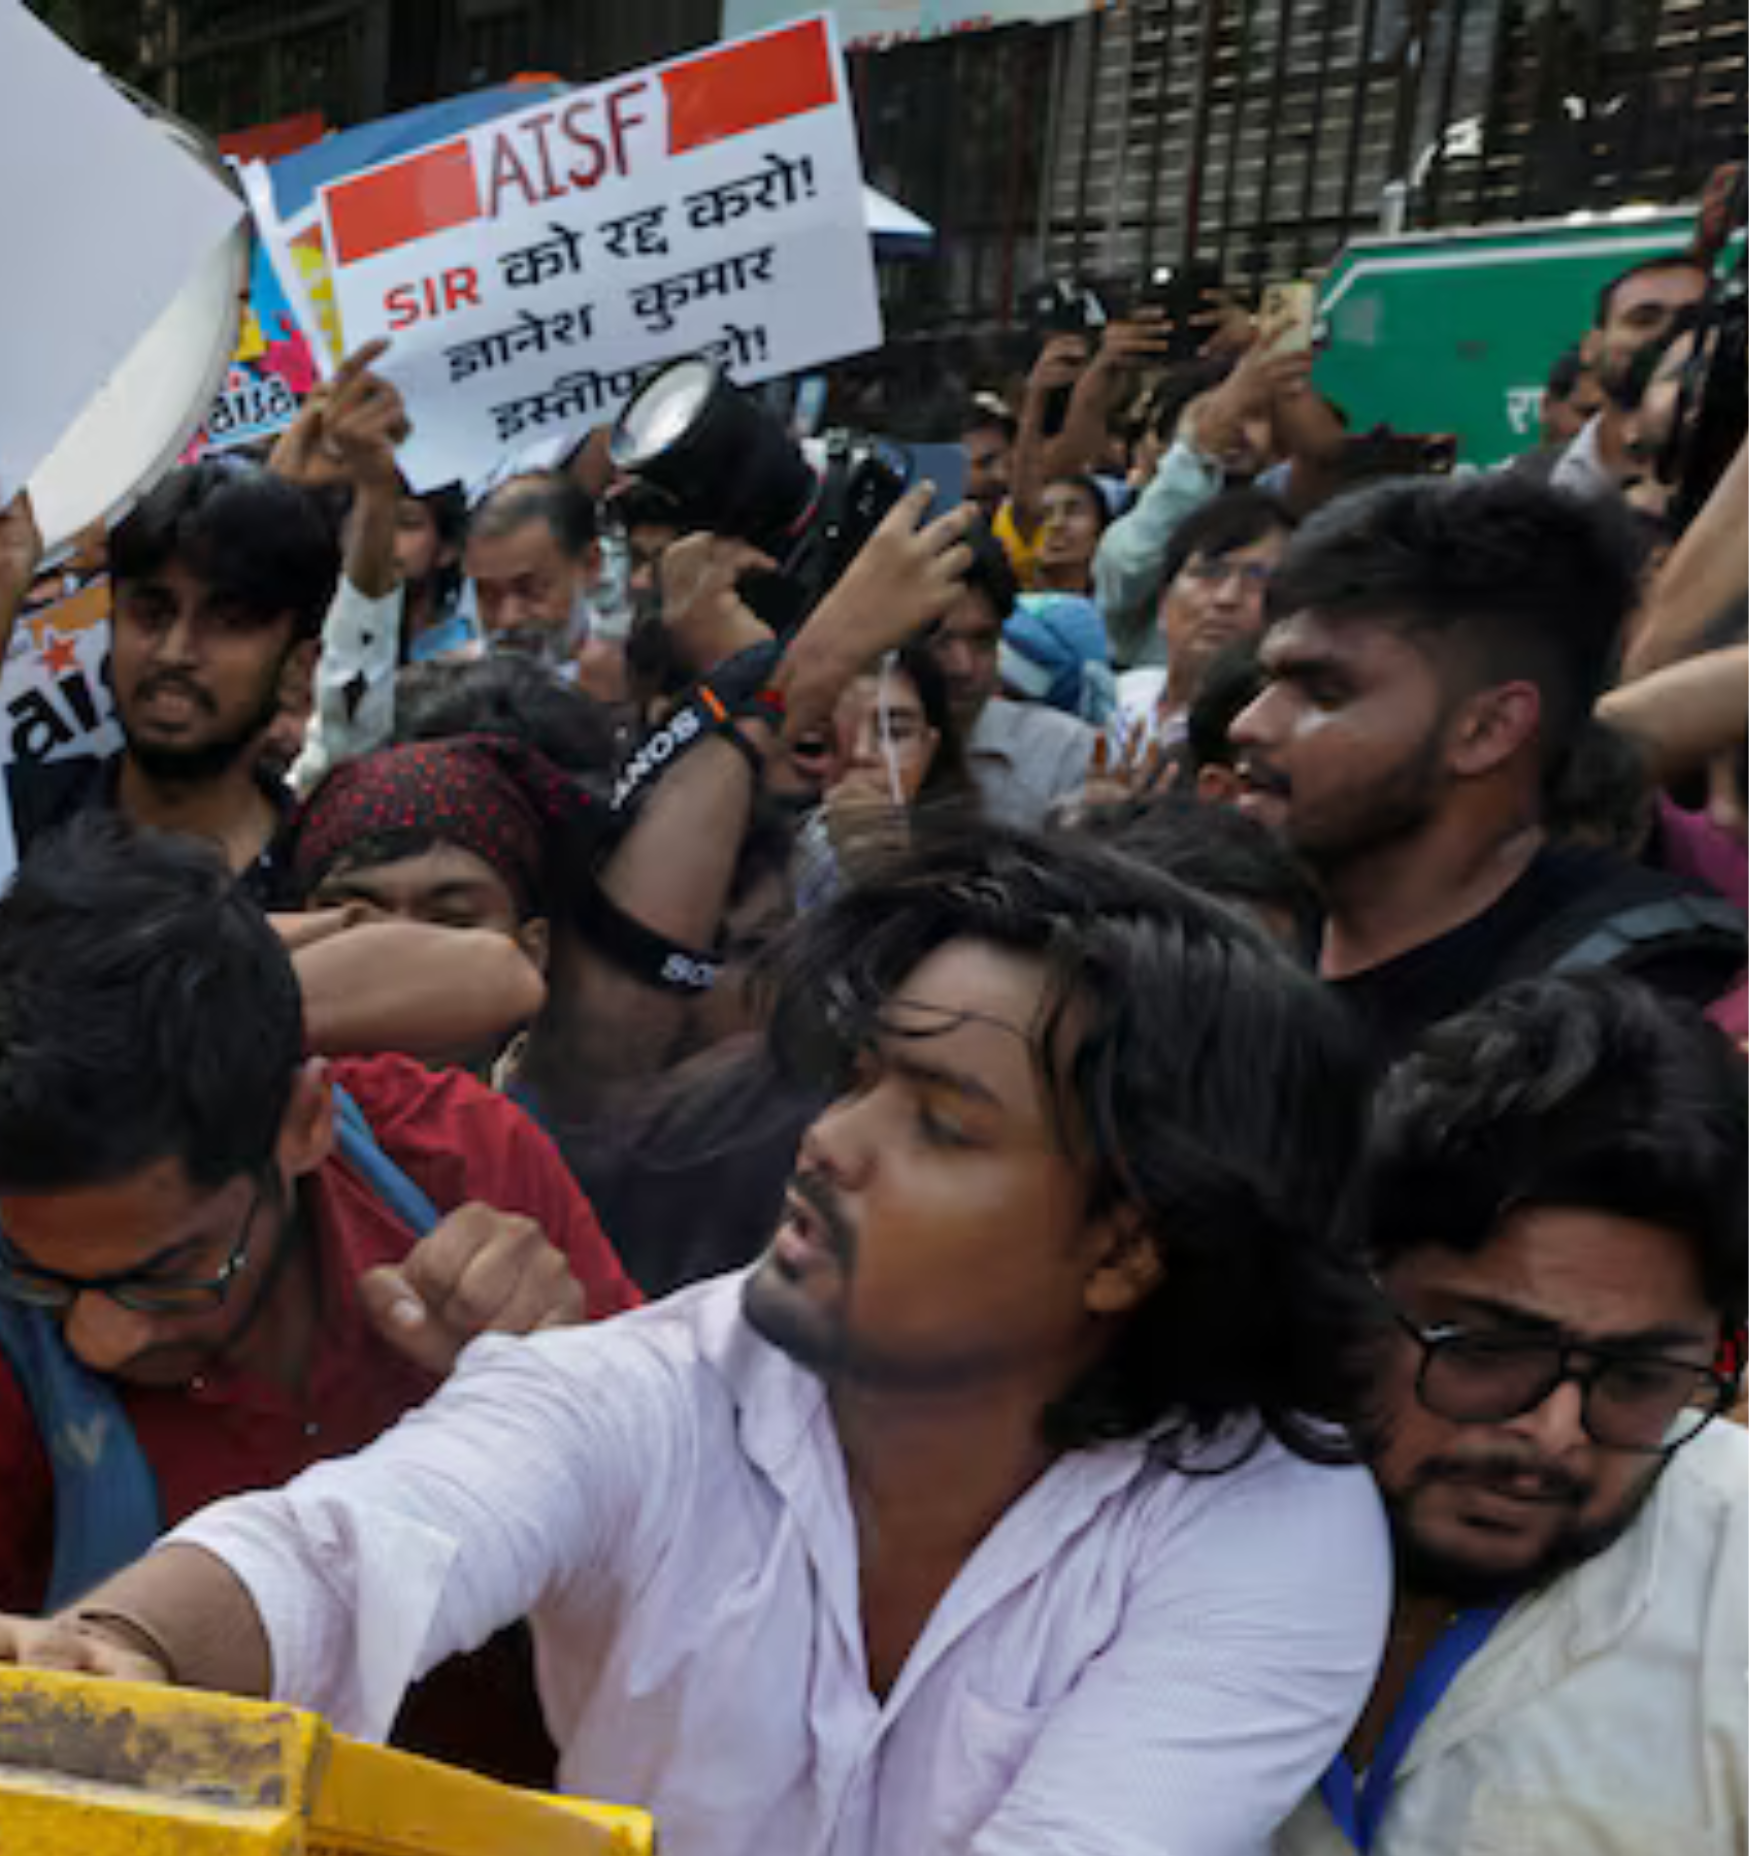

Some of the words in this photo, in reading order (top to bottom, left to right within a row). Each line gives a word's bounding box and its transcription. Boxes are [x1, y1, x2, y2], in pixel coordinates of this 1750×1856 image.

[485, 81, 648, 216] AISF
[383, 267, 481, 330] SIR
[498, 223, 583, 291] को
[684, 154, 817, 230] करो!
[441, 301, 594, 384] ज्ञानेश
[629, 245, 778, 333] कुमार
